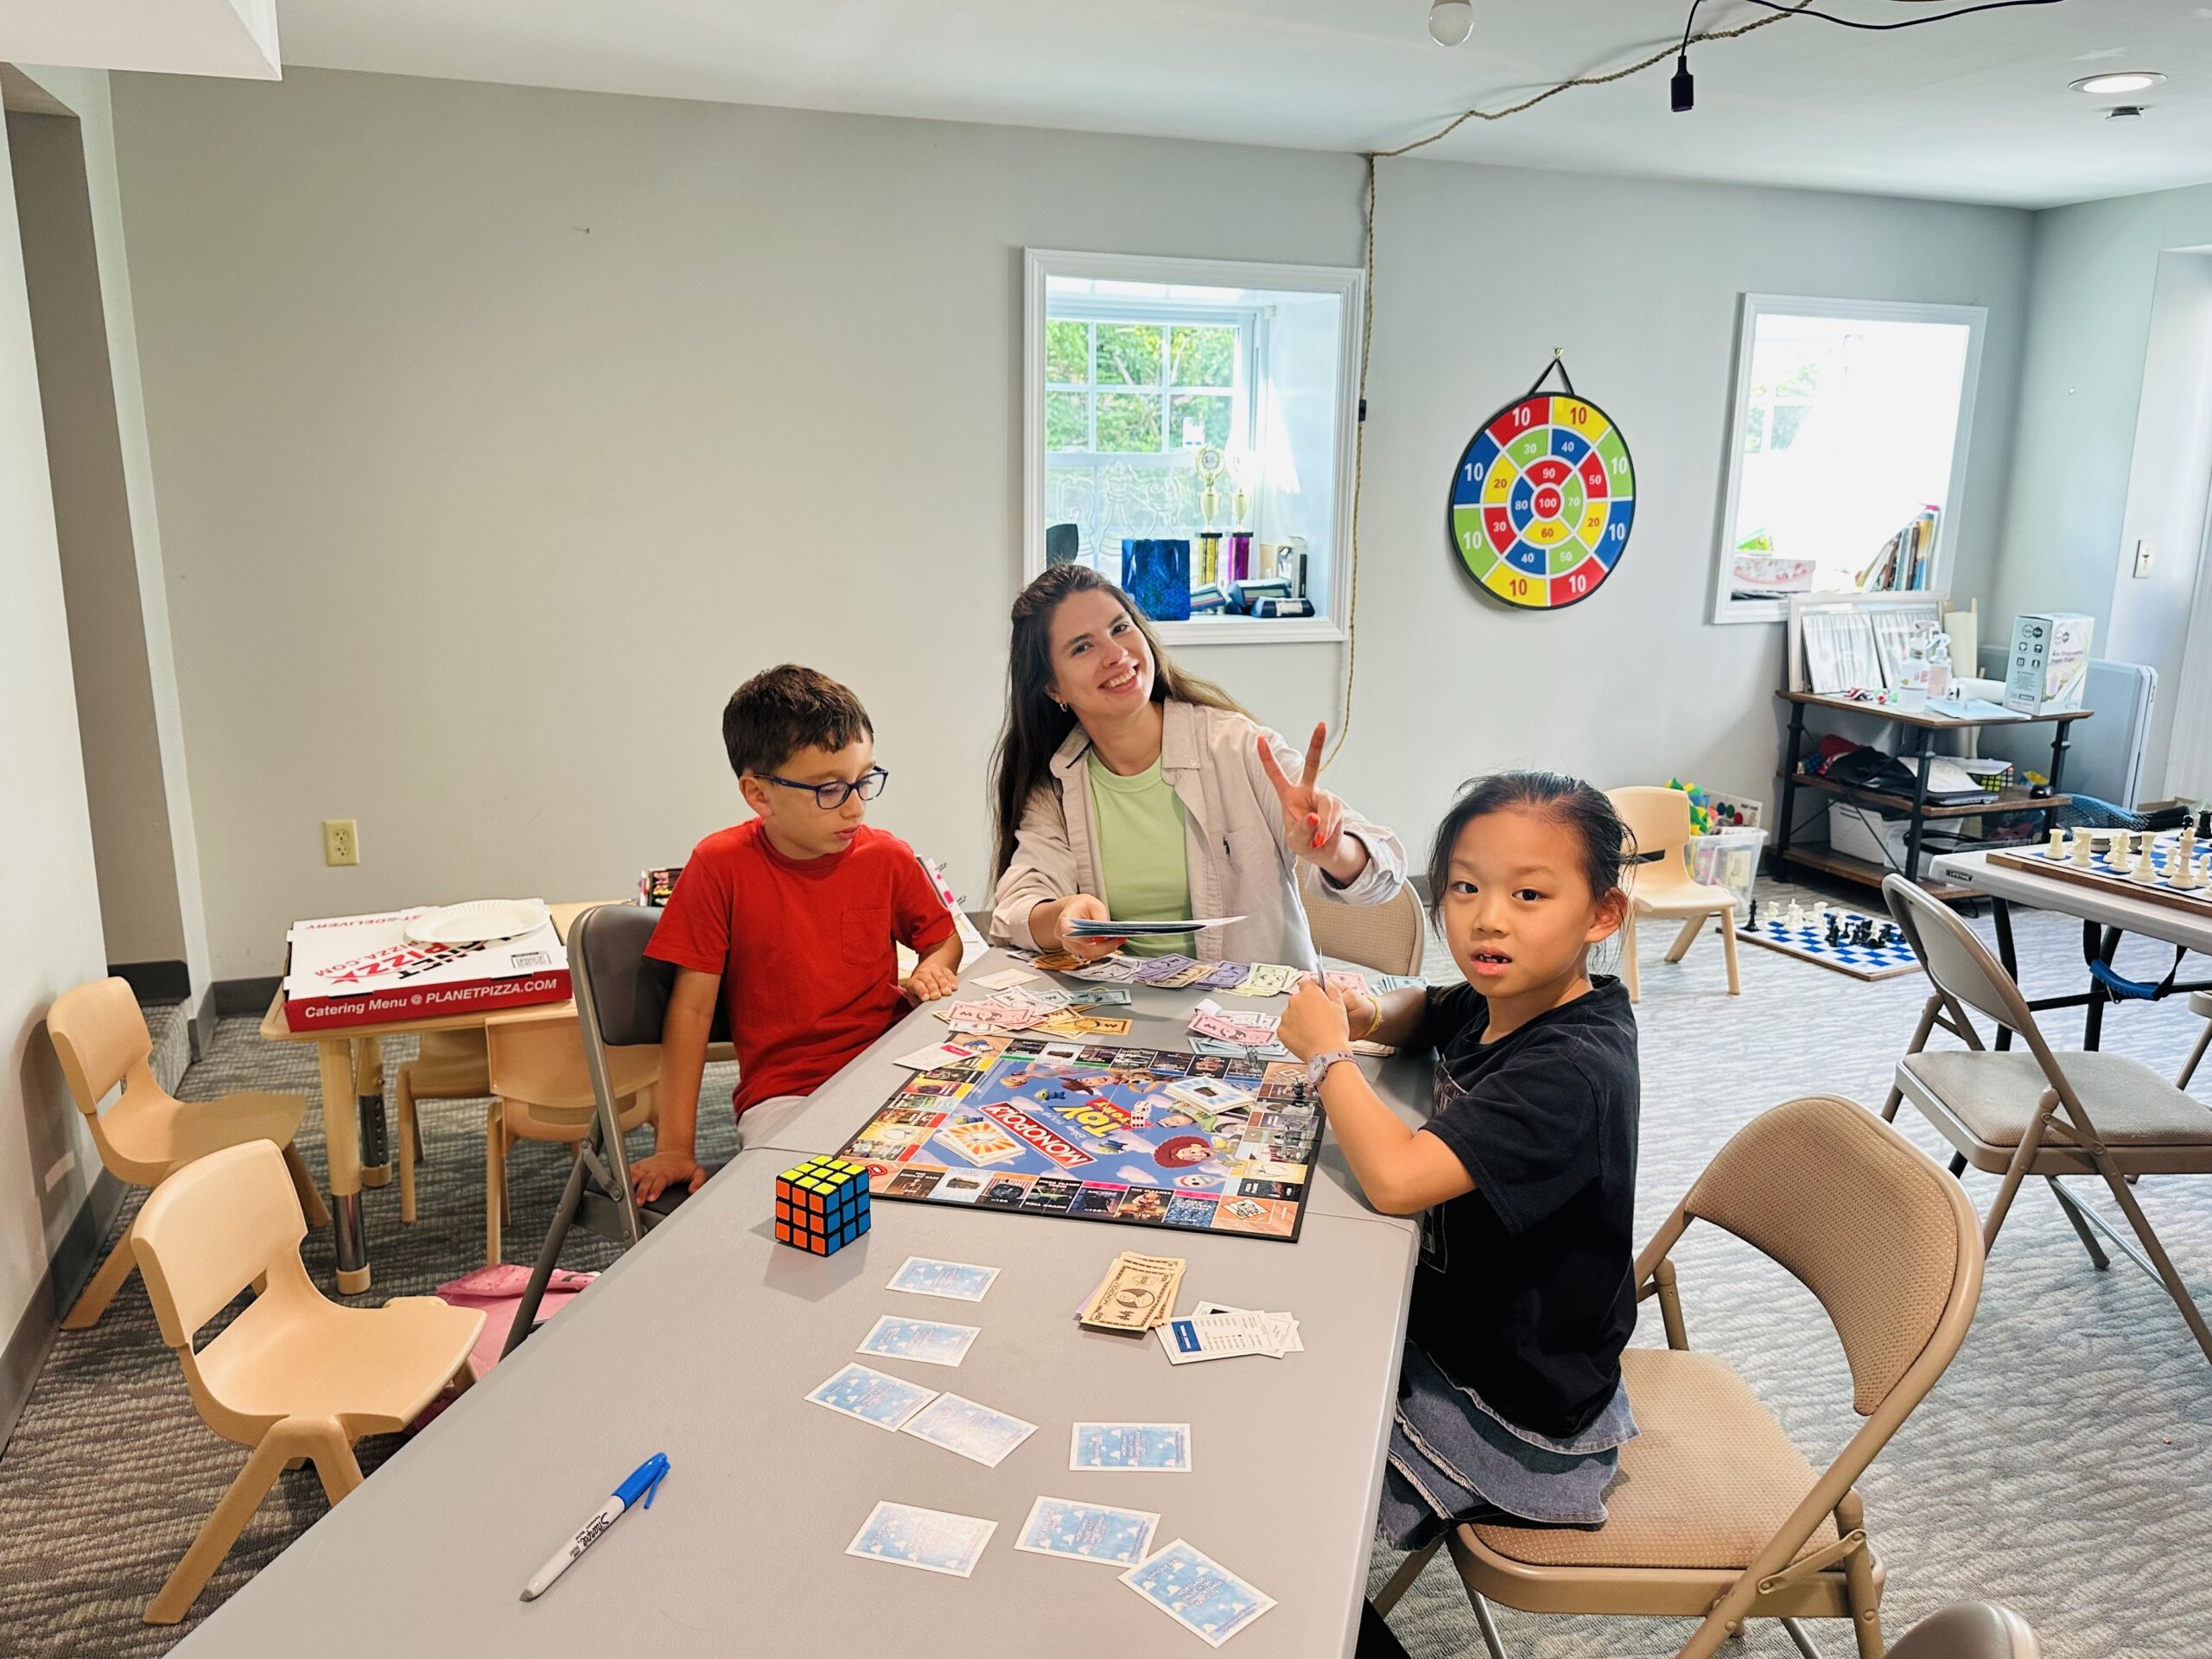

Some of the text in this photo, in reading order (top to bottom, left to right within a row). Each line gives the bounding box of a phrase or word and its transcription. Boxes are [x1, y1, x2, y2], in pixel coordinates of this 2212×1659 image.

[1512, 407, 1531, 426] 10
[1570, 406, 1587, 425] 10
[1523, 443, 1537, 454] 30
[1561, 442, 1574, 452] 40
[1465, 462, 1484, 481] 10
[1611, 456, 1628, 474] 10
[1542, 468, 1555, 479] 90
[1589, 475, 1601, 485] 50
[1493, 479, 1507, 489] 20
[1515, 499, 1529, 510] 80
[1538, 498, 1557, 509] 100
[1567, 497, 1580, 507] 70
[1493, 521, 1507, 532] 30
[1587, 518, 1599, 528] 20
[1541, 528, 1554, 538] 60
[1609, 523, 1625, 541] 10
[1463, 531, 1482, 550] 10
[1521, 553, 1535, 563] 40
[1560, 551, 1573, 562] 50
[1510, 579, 1527, 596] 10
[1568, 574, 1586, 593] 10
[304, 918, 388, 931] DELIVERY
[305, 978, 557, 1019] Catering Menu @ PLANETPIZZA.COM
[1053, 1106, 1122, 1138] TOY
[985, 1106, 1089, 1165] MONOPOLY
[1147, 1564, 1168, 1580] ANTIQUE
[1177, 1576, 1205, 1596] MORTGAGE
